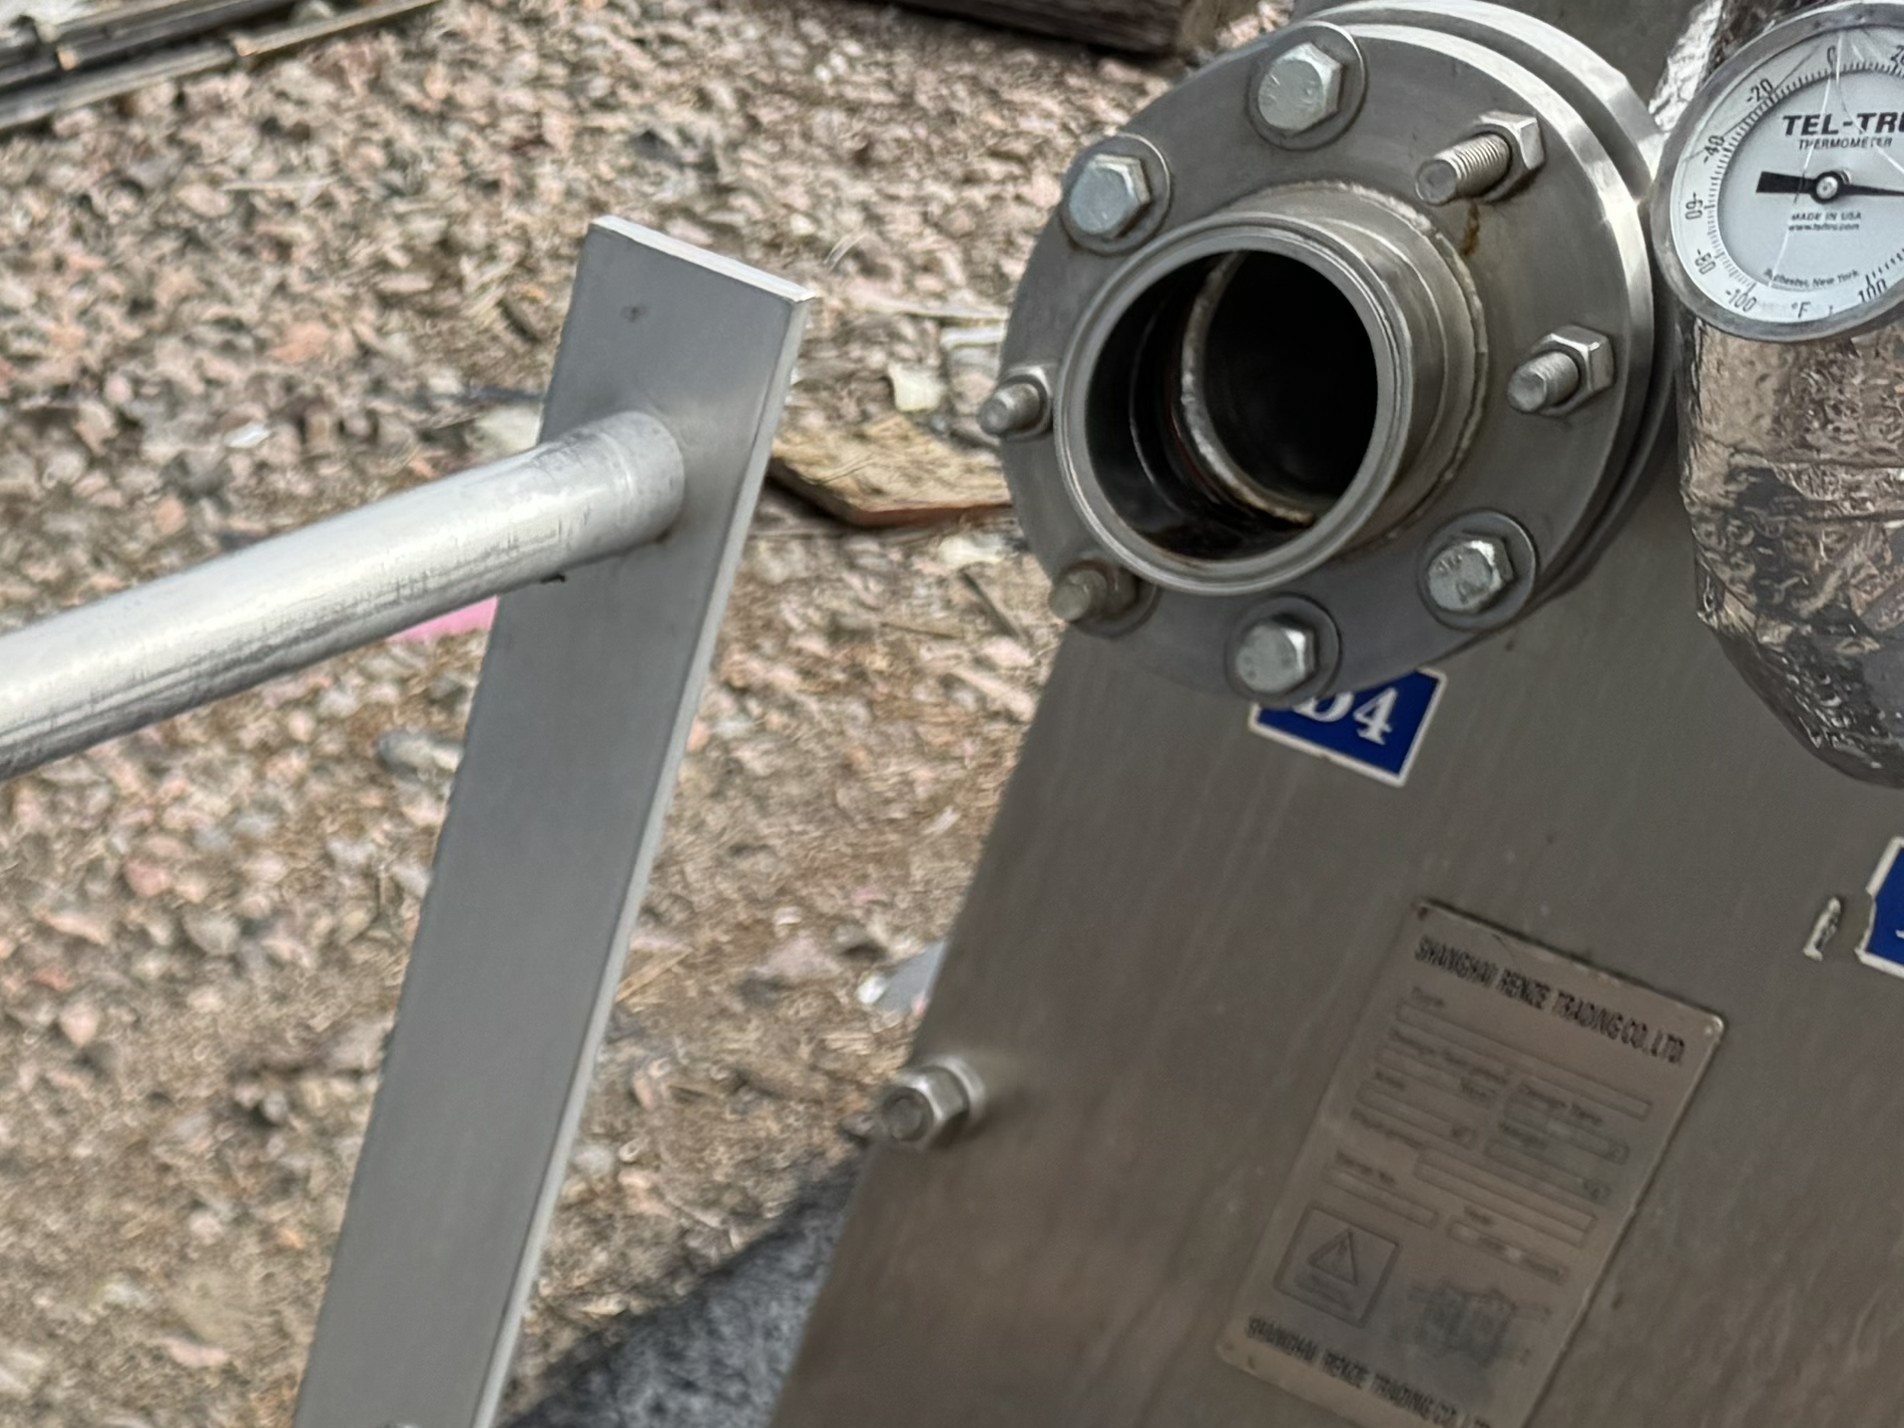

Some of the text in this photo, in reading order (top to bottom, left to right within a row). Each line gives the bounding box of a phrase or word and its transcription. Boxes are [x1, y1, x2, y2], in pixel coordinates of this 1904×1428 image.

[1791, 211, 1862, 222] MADE IN USA
